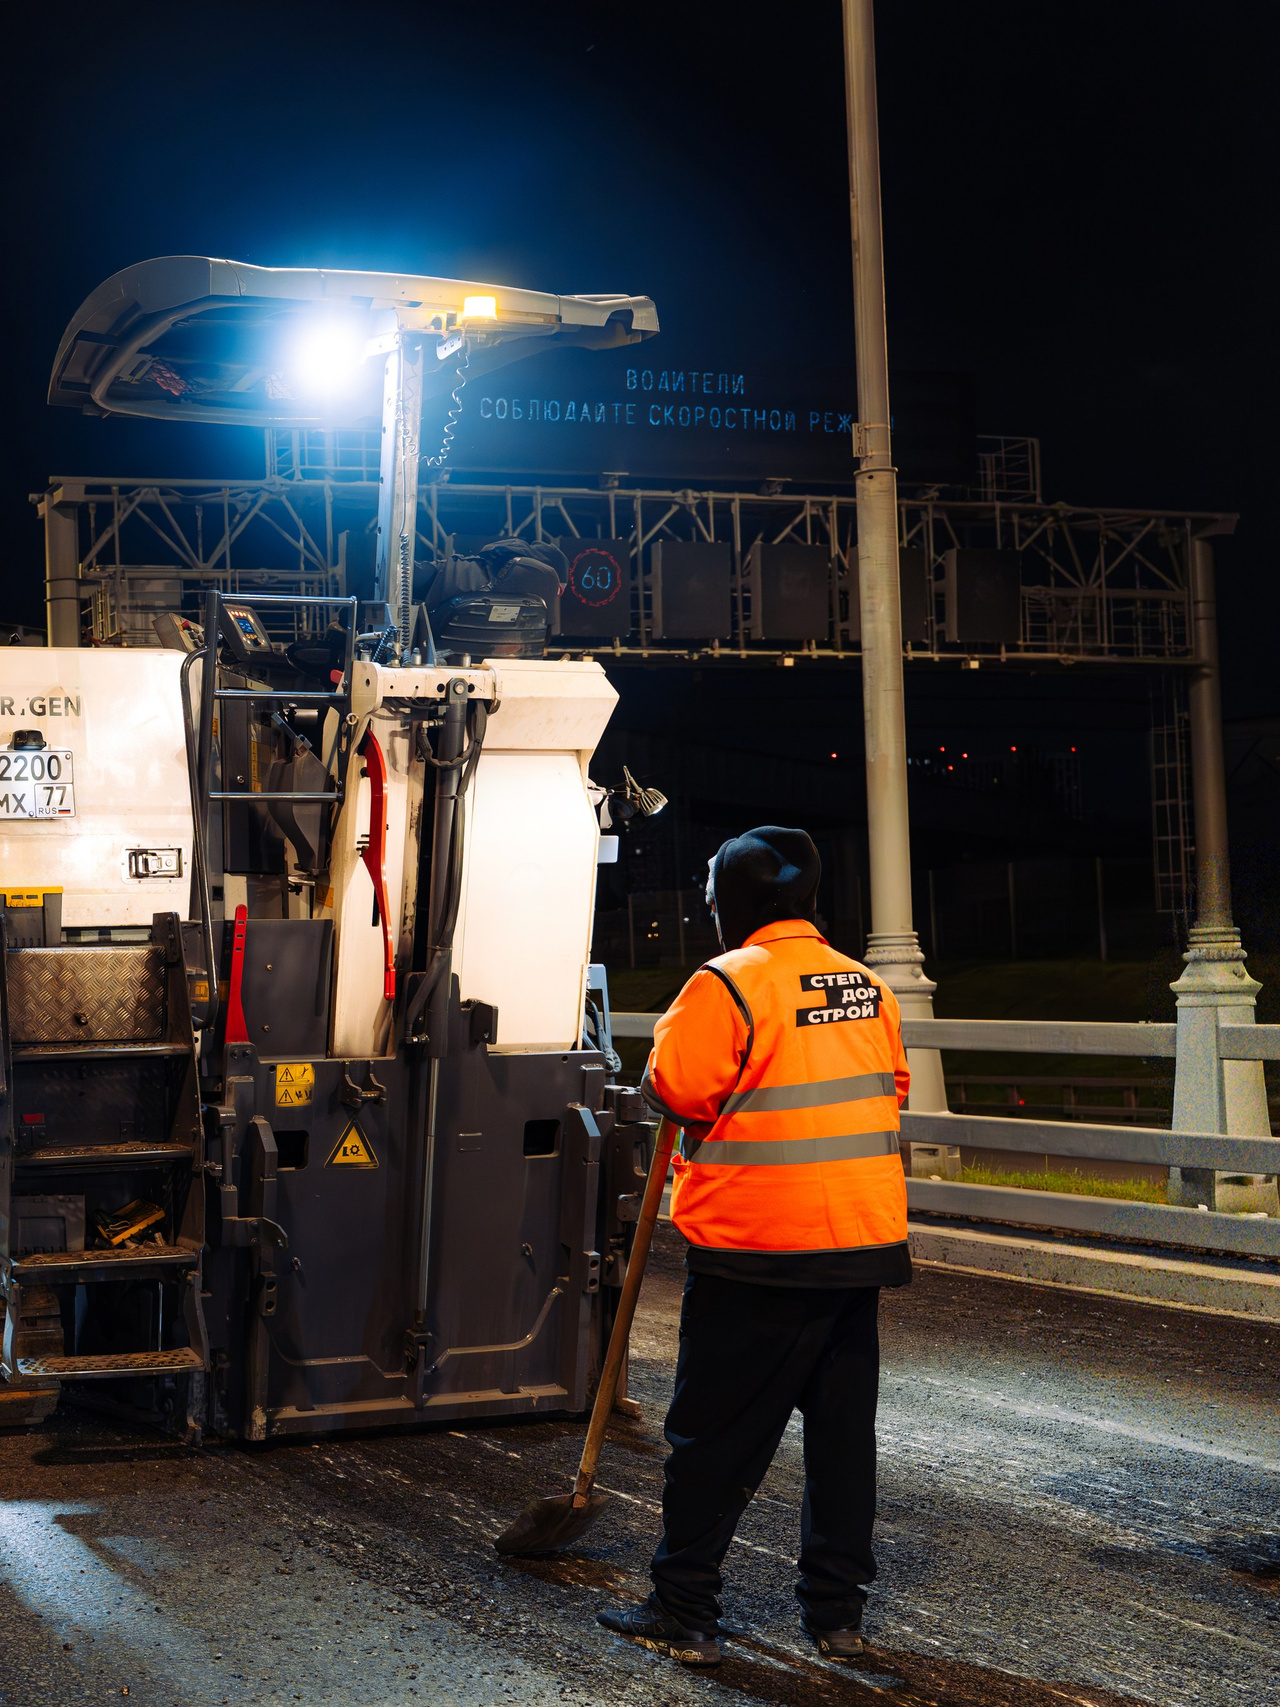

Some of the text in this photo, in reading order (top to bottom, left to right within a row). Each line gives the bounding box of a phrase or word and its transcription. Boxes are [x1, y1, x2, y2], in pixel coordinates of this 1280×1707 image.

[626, 369, 744, 395] ВОДИТЕЛИ
[480, 397, 637, 425] СОБЛЮДАЙТЕ
[649, 404, 796, 431] СКОРОСТНОЙ
[581, 566, 611, 589] 60
[42, 786, 67, 806] 77
[38, 807, 57, 815] RUS
[810, 973, 862, 988] СТЕП
[842, 987, 877, 1003] ДОР
[807, 1001, 875, 1023] СТРОЙ
